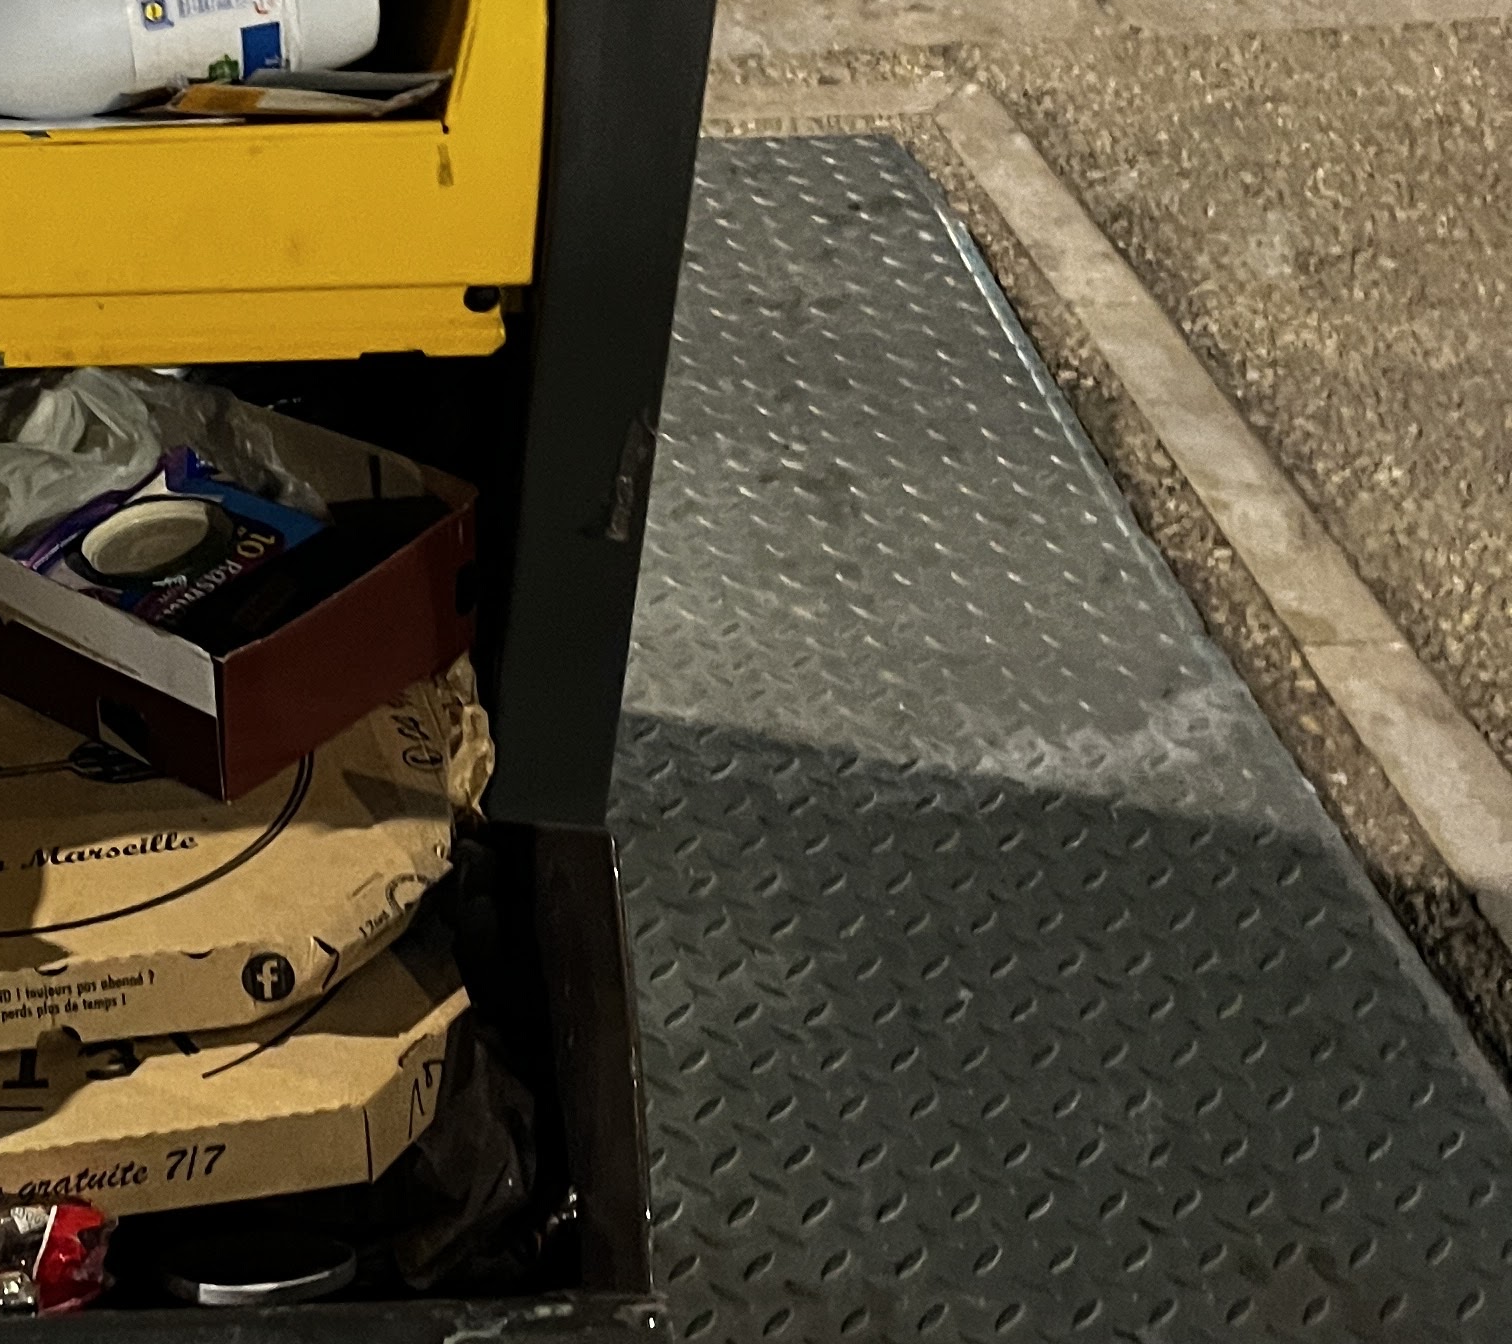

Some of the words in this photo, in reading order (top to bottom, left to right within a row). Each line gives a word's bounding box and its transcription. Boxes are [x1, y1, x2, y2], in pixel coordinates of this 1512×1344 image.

[236, 532, 276, 559] 10
[20, 831, 199, 870] Marseille
[25, 983, 73, 1001] toujours
[76, 980, 97, 998] pas
[1, 1002, 33, 1024] perds
[36, 998, 61, 1019] plus
[64, 998, 79, 1014] de
[82, 995, 118, 1013] temps
[16, 1161, 149, 1205] gratuite
